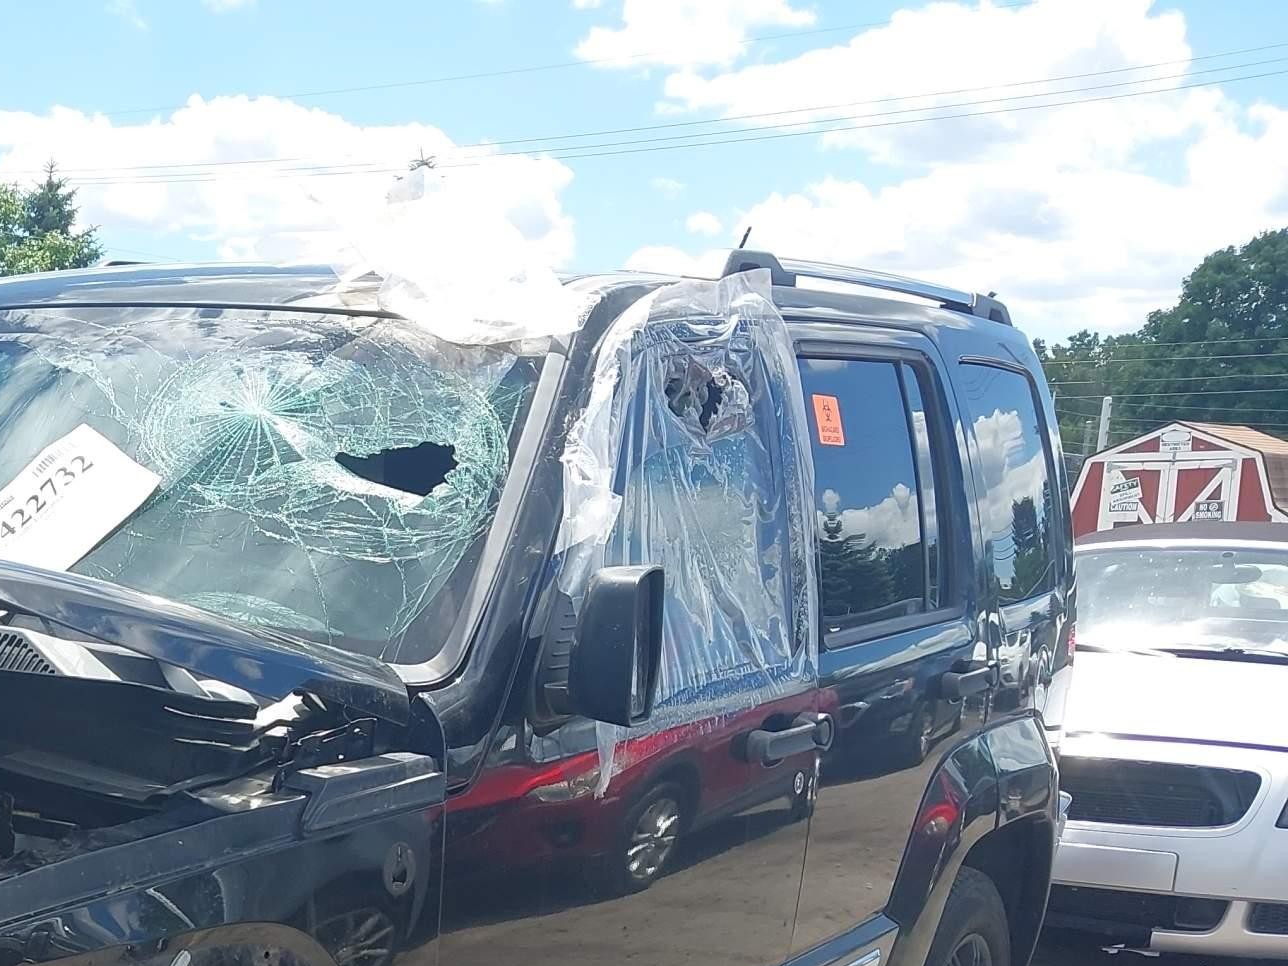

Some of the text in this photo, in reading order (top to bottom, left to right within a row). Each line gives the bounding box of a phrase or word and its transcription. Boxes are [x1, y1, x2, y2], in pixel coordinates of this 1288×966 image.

[1111, 503, 1137, 511] CAUTION
[1199, 503, 1208, 511] NO
[1195, 511, 1222, 519] SMOKING
